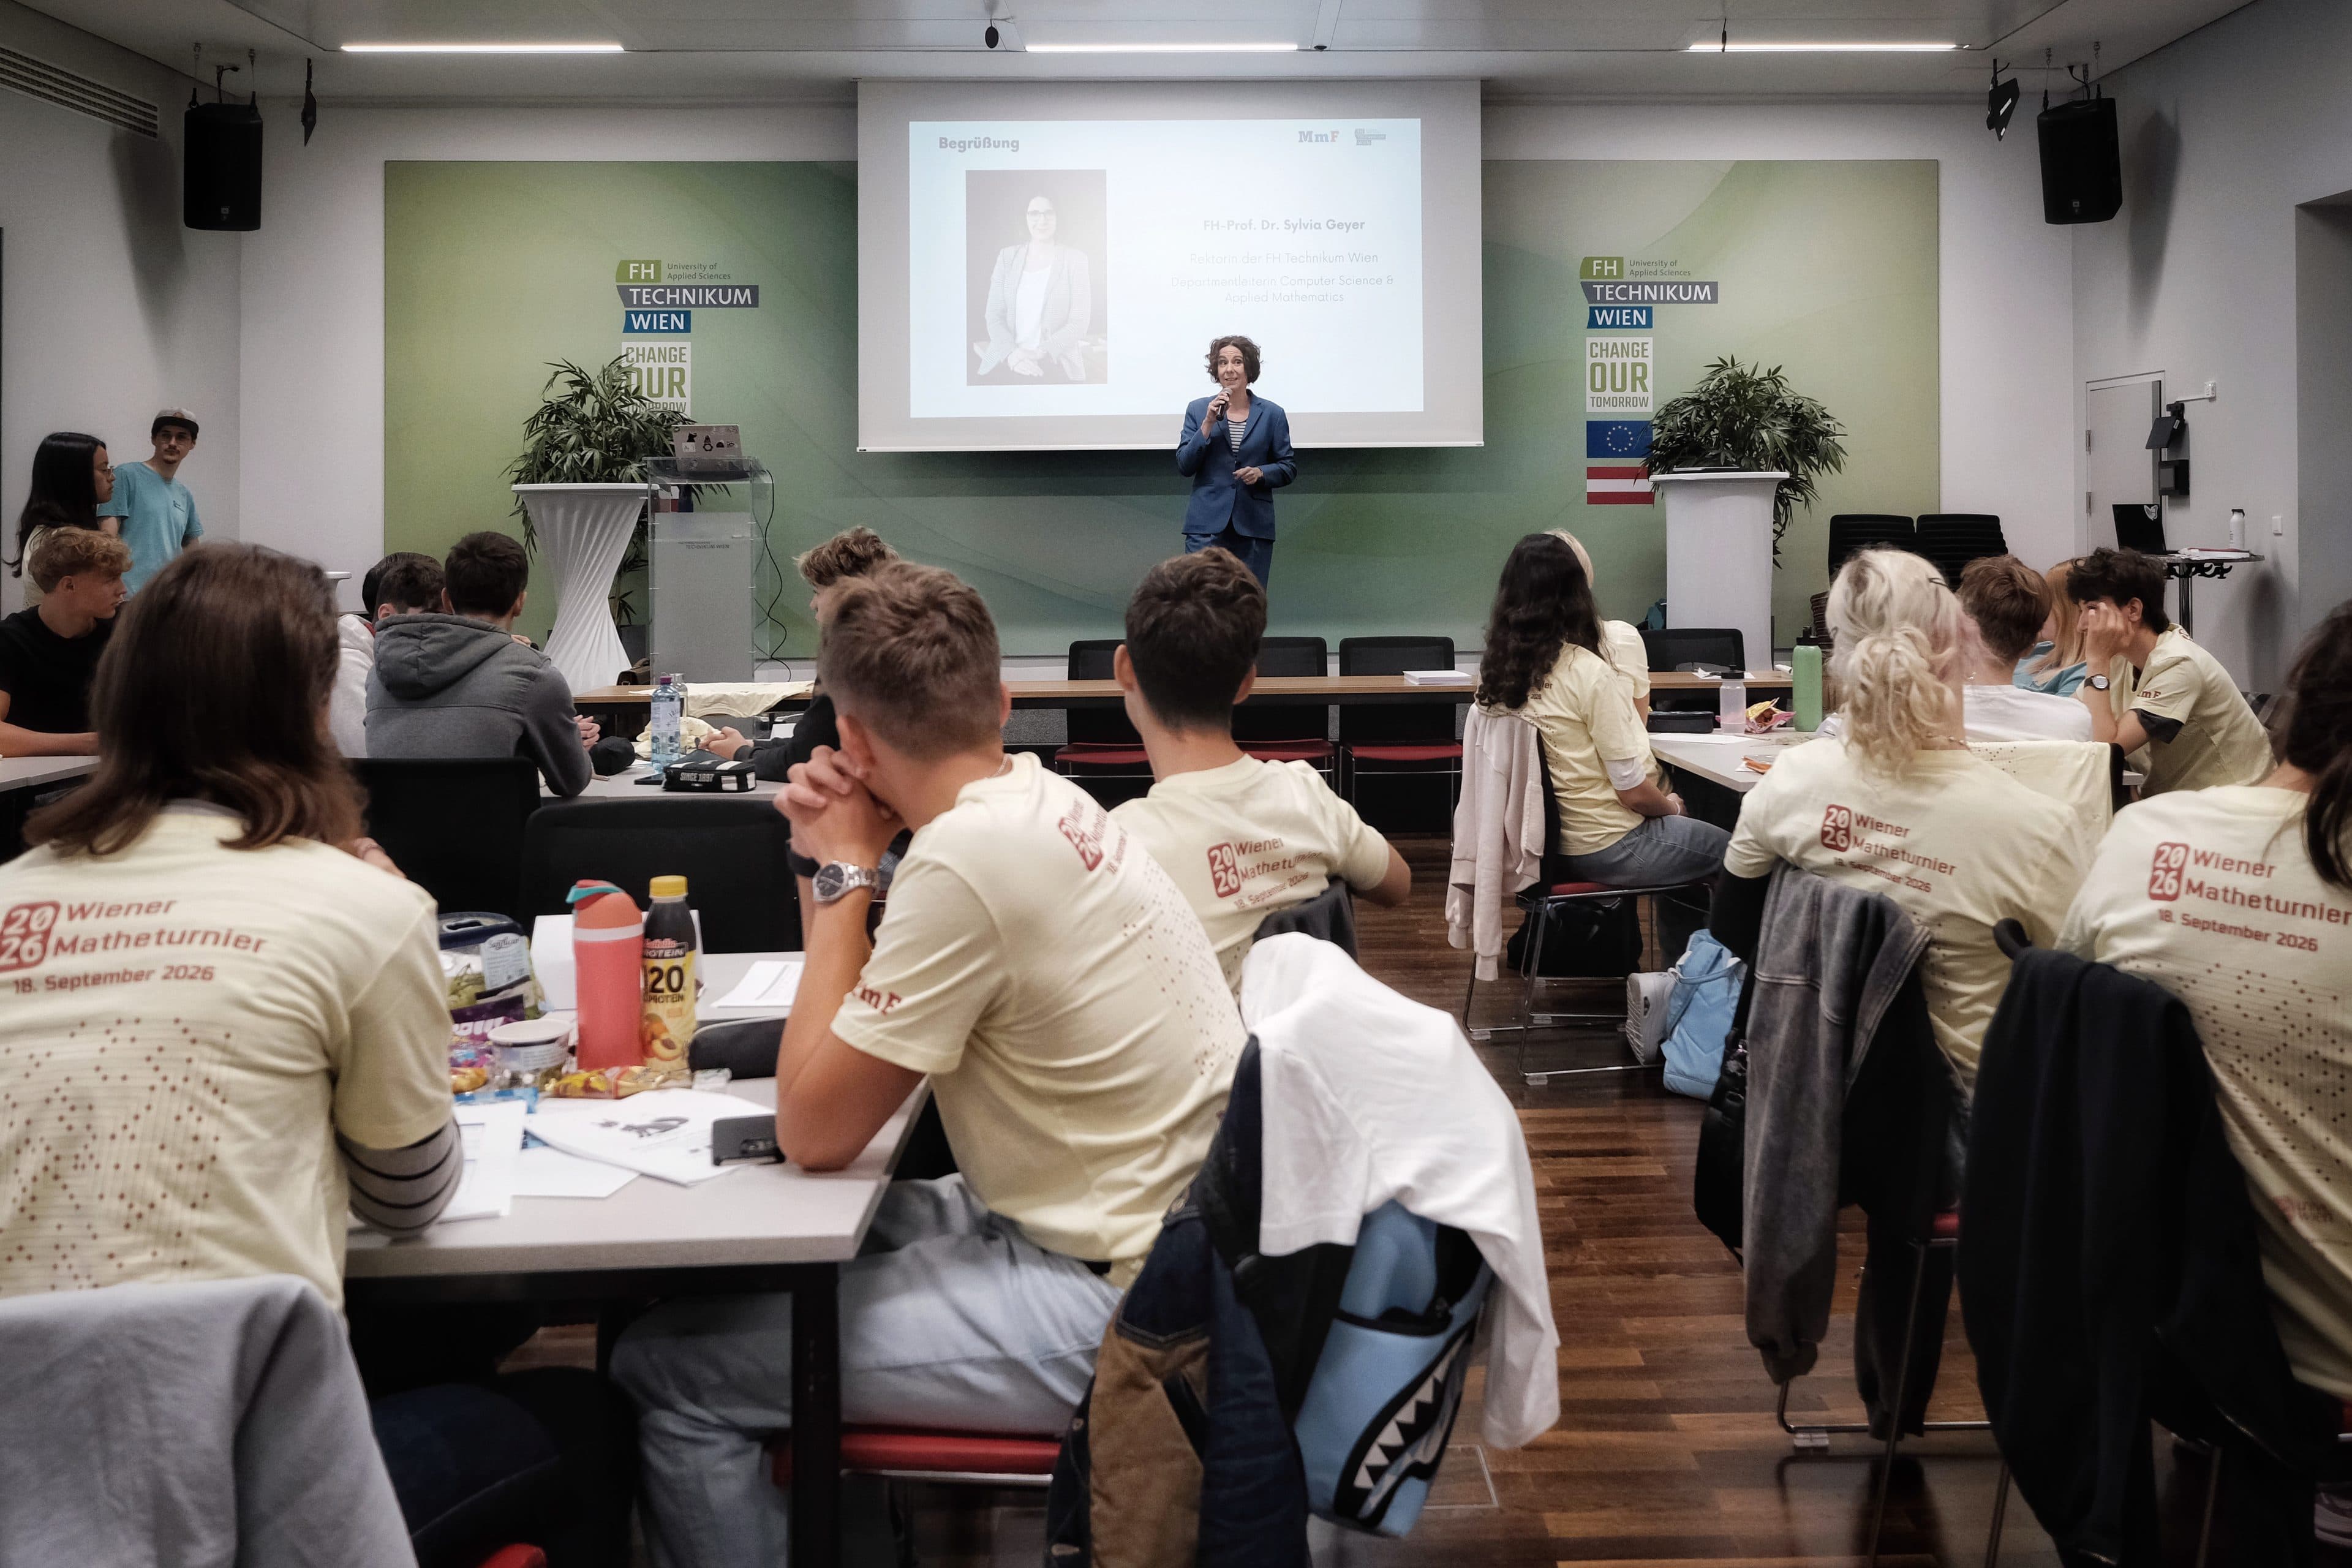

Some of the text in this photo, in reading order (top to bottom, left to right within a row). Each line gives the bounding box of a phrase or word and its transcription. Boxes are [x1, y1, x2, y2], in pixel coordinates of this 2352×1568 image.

[939, 137, 1020, 153] Begrüßung
[1298, 130, 1340, 143] MmF
[1204, 218, 1365, 234] FH-Prof. Dr. Sylvia Geyer
[668, 263, 707, 271] University
[1190, 251, 1378, 265] Rektorin der FH Technikum Wien
[1629, 260, 1668, 268] University
[629, 263, 654, 279] FH
[1593, 260, 1617, 276] FH
[1629, 269, 1657, 277] Applied
[1171, 274, 1393, 290] Departmentleiterin Computer Science &
[629, 288, 752, 304] TECHNIKUM
[1225, 291, 1344, 306] Applied Mathematics
[1593, 284, 1711, 301] TECHNIKUM
[631, 314, 684, 330] WIEN
[1594, 309, 1646, 325] WIEN
[626, 347, 687, 363] CHANGE
[1589, 342, 1649, 358] CHANGE
[1590, 362, 1649, 393] OUR
[1591, 396, 1649, 407] TOMORROW
[1824, 807, 1850, 828] 20
[1855, 813, 1910, 838] Wiener
[1822, 826, 1849, 848] 26
[1209, 845, 1235, 872] 20
[1852, 835, 1956, 876] Matheturnier
[2154, 845, 2187, 870] 20
[2193, 849, 2278, 878] Wiener
[1214, 867, 1238, 892] 26
[1905, 876, 1932, 893] 2026
[2150, 869, 2179, 895] 26
[66, 900, 178, 922] Wiener
[2185, 878, 2352, 926] Matheturnier
[4, 905, 58, 936] 20
[2180, 913, 2272, 942] September
[2275, 932, 2319, 952] 2026
[0, 935, 45, 965] 26
[53, 928, 268, 957] Matheturnier
[14, 965, 217, 994] 18. September 2026
[649, 965, 684, 993] 20
[859, 984, 902, 1017] mF
